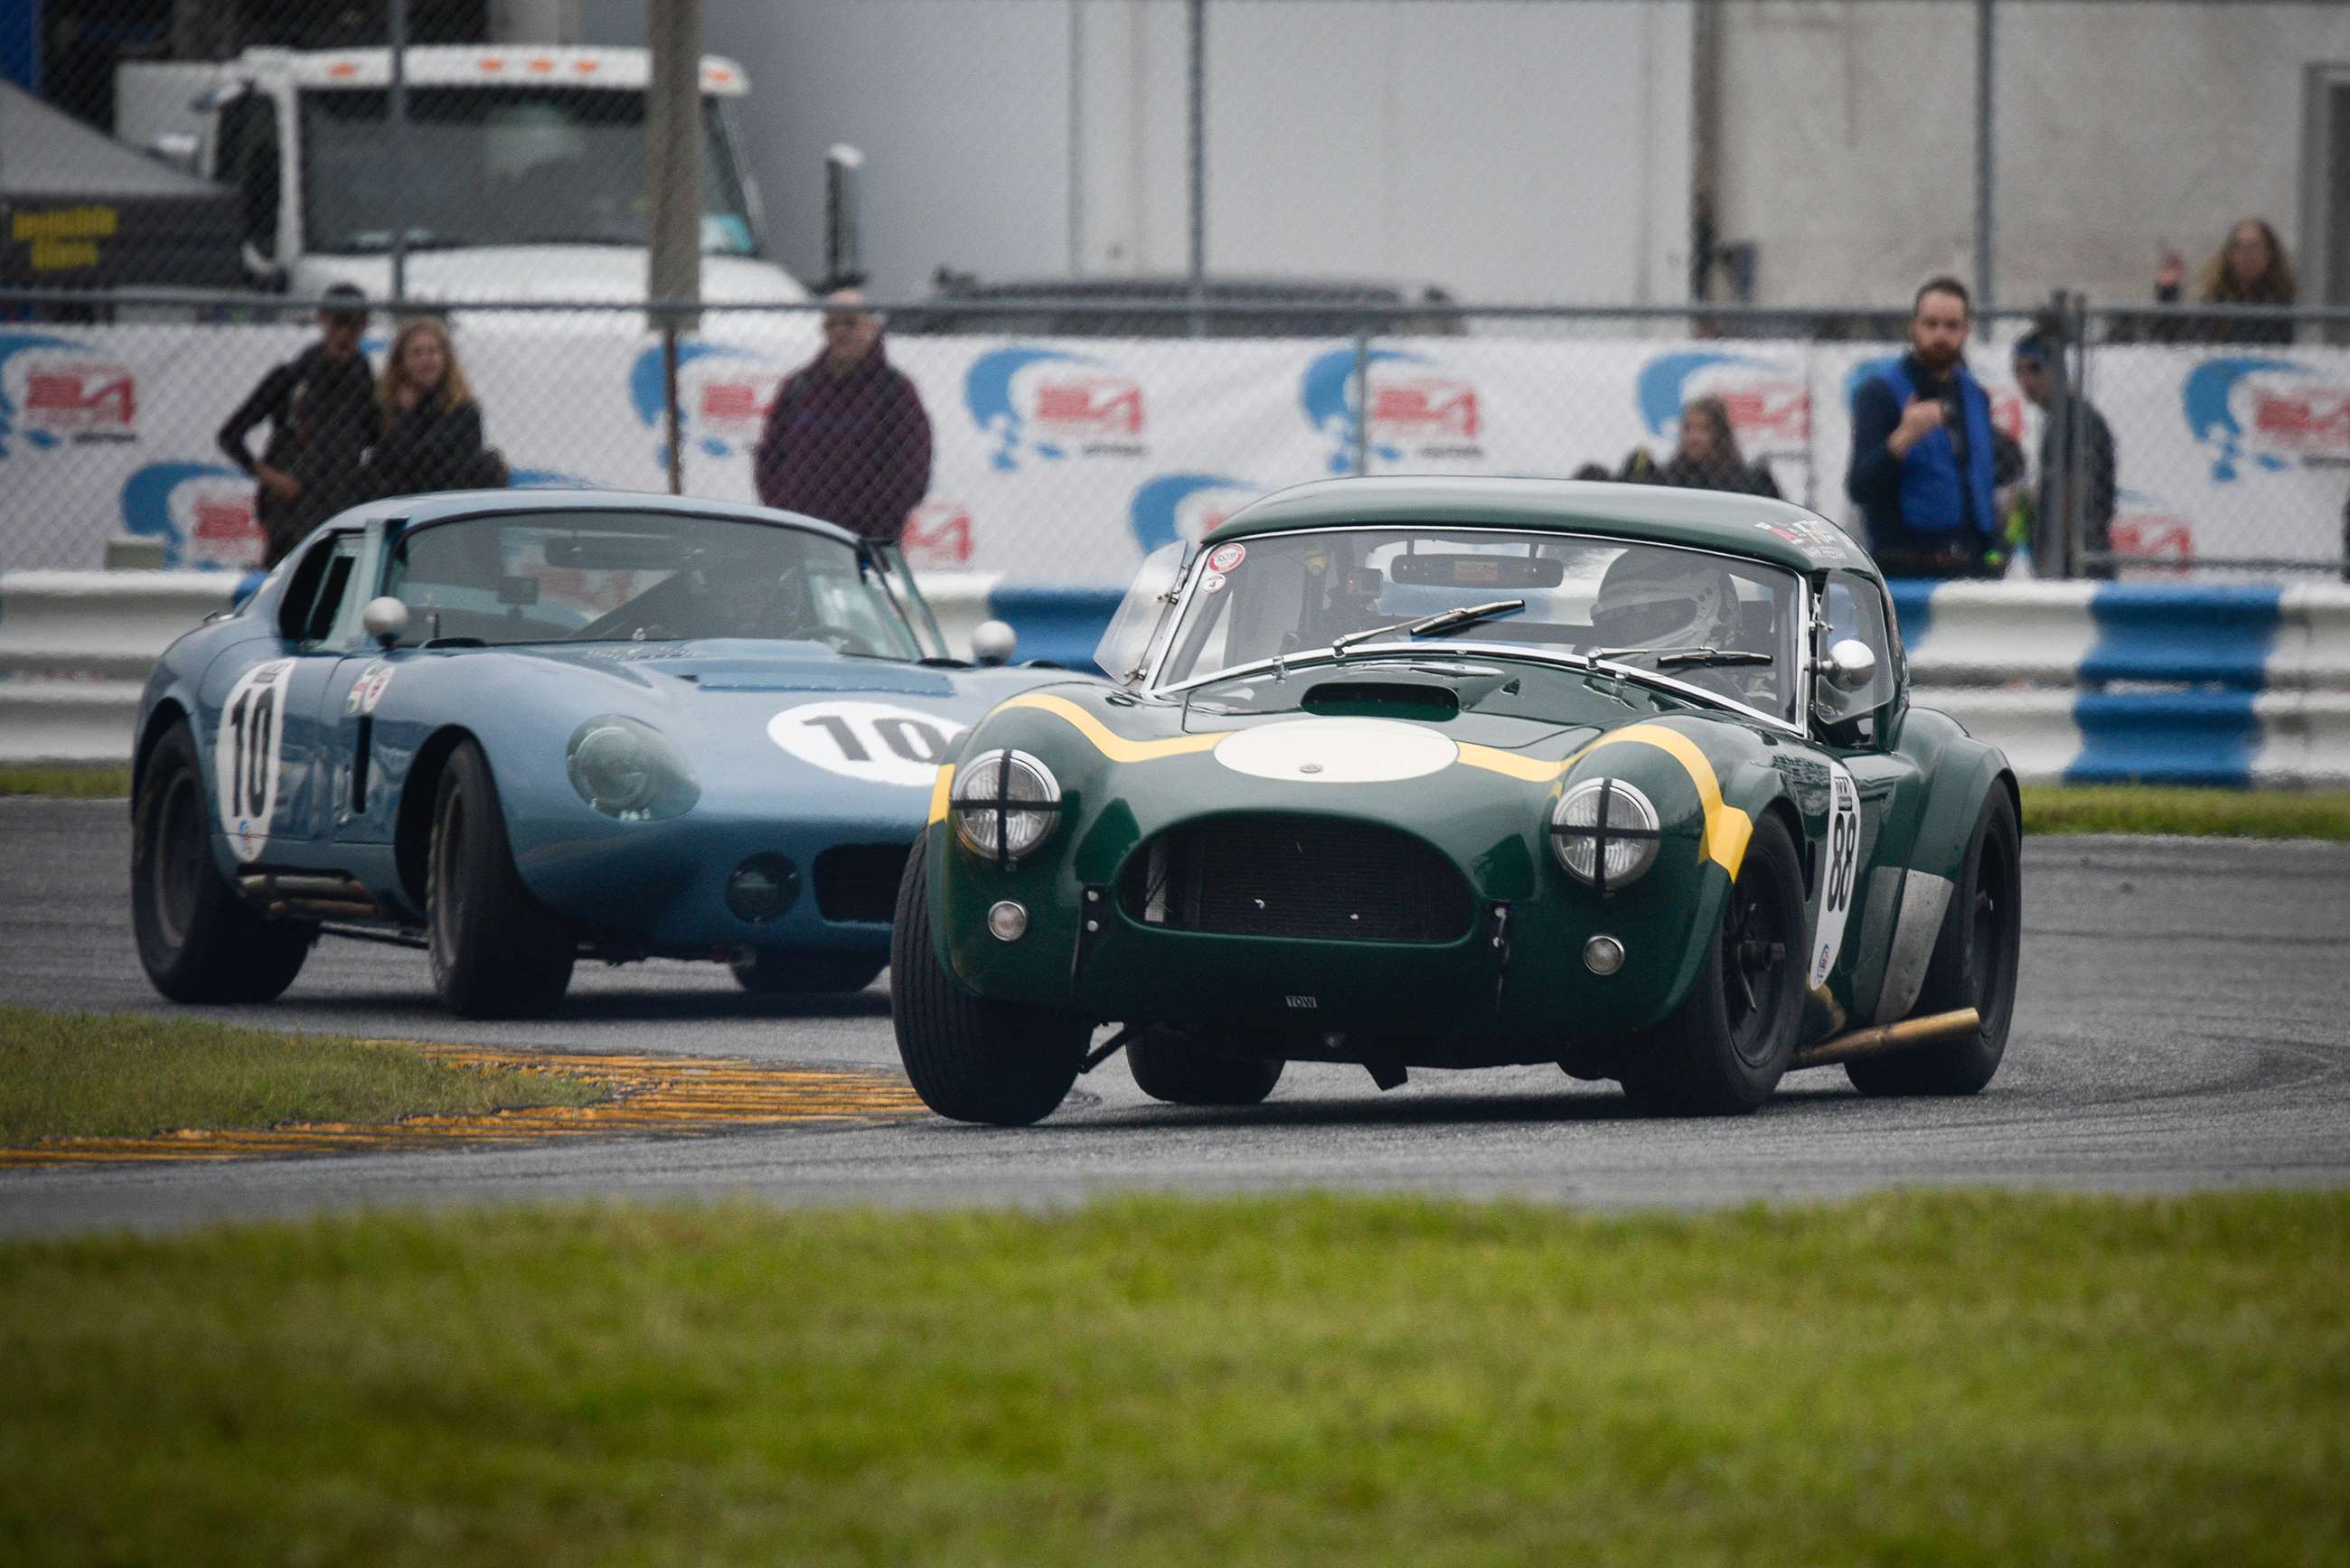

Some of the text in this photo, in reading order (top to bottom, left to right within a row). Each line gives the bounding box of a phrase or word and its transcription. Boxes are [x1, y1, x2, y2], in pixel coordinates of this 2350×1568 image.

[230, 685, 276, 818] 10
[802, 715, 951, 765] 10
[1827, 812, 1856, 913] 88
[1284, 995, 1317, 1009] TOW
